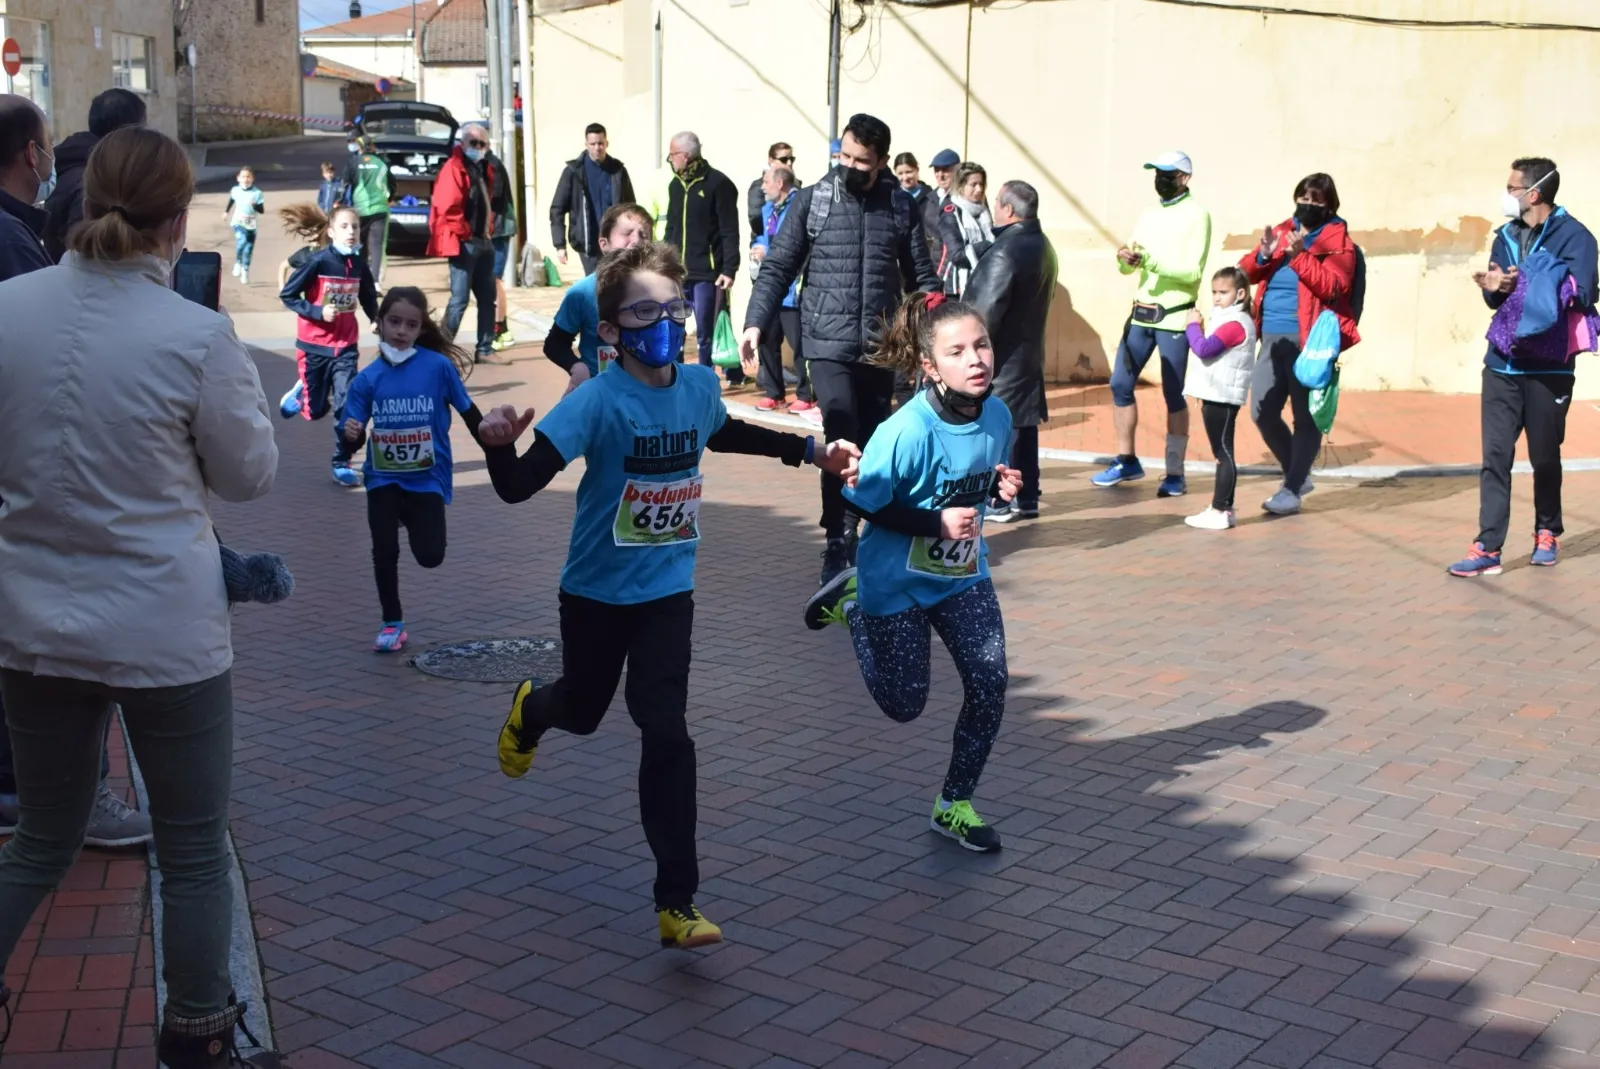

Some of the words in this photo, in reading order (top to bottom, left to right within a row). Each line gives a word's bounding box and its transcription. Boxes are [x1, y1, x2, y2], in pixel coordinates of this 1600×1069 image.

[330, 294, 352, 305] 645
[382, 395, 434, 414] ARMUÑA
[371, 430, 431, 444] bedunia
[384, 443, 421, 461] 657
[623, 480, 702, 504] bedunia
[633, 503, 685, 530] 656
[928, 537, 974, 563] 647
